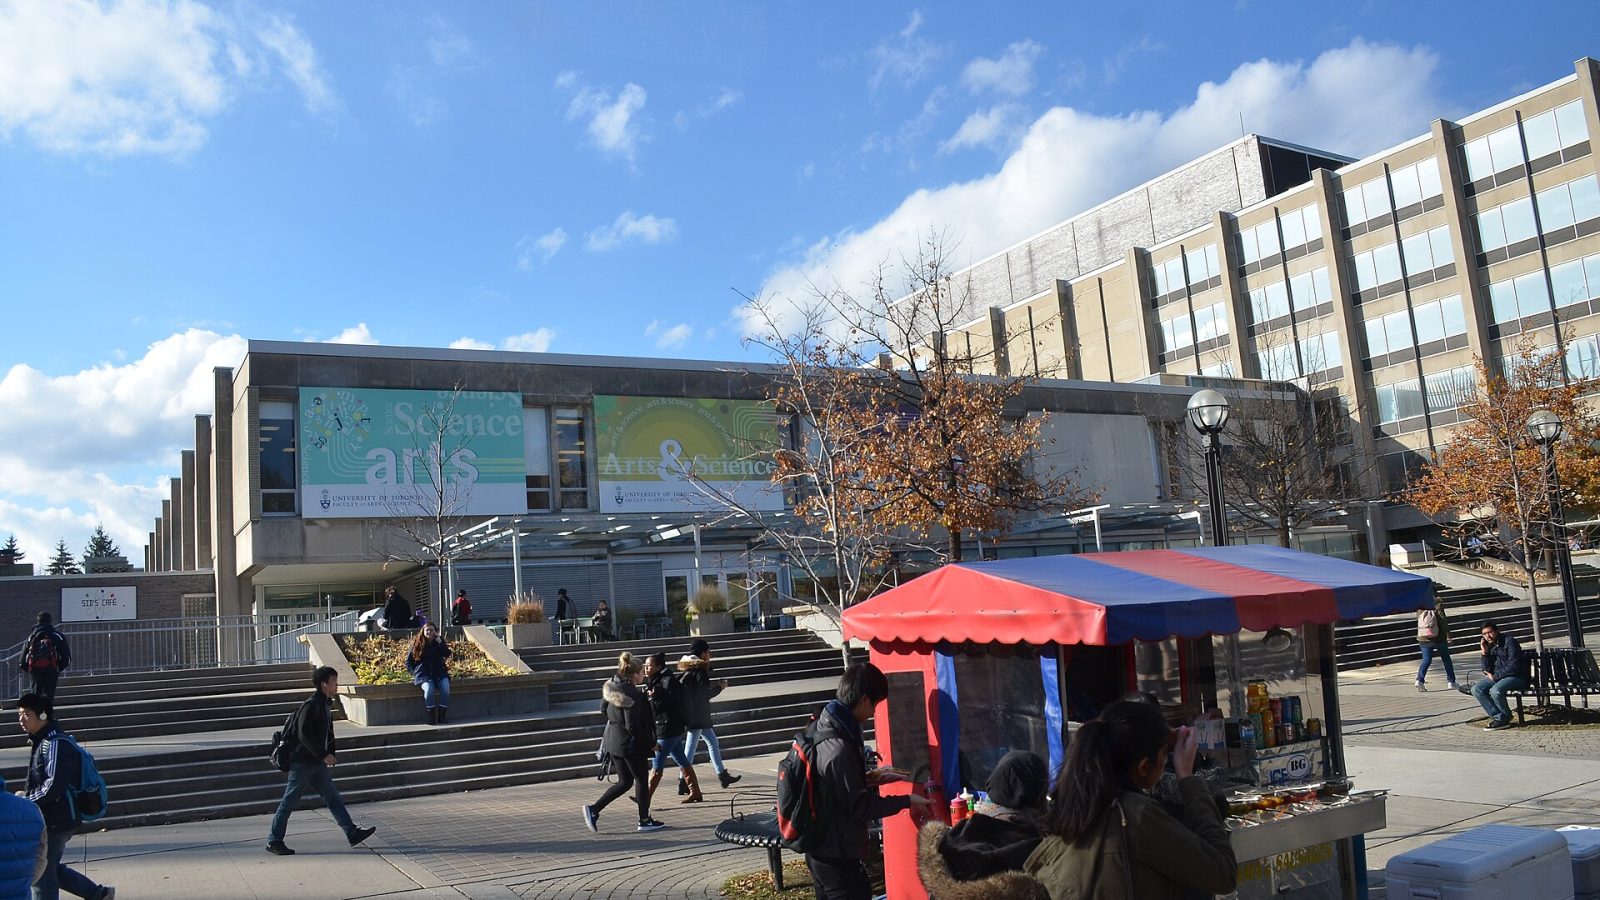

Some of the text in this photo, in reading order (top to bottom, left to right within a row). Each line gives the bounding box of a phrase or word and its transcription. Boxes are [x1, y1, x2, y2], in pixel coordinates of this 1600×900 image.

[394, 402, 522, 437] Science
[365, 441, 480, 485] arts
[604, 453, 777, 475] Arts Science
[658, 439, 692, 481] &
[81, 597, 117, 607] SID'S CAFÉ
[1291, 758, 1306, 771] BG
